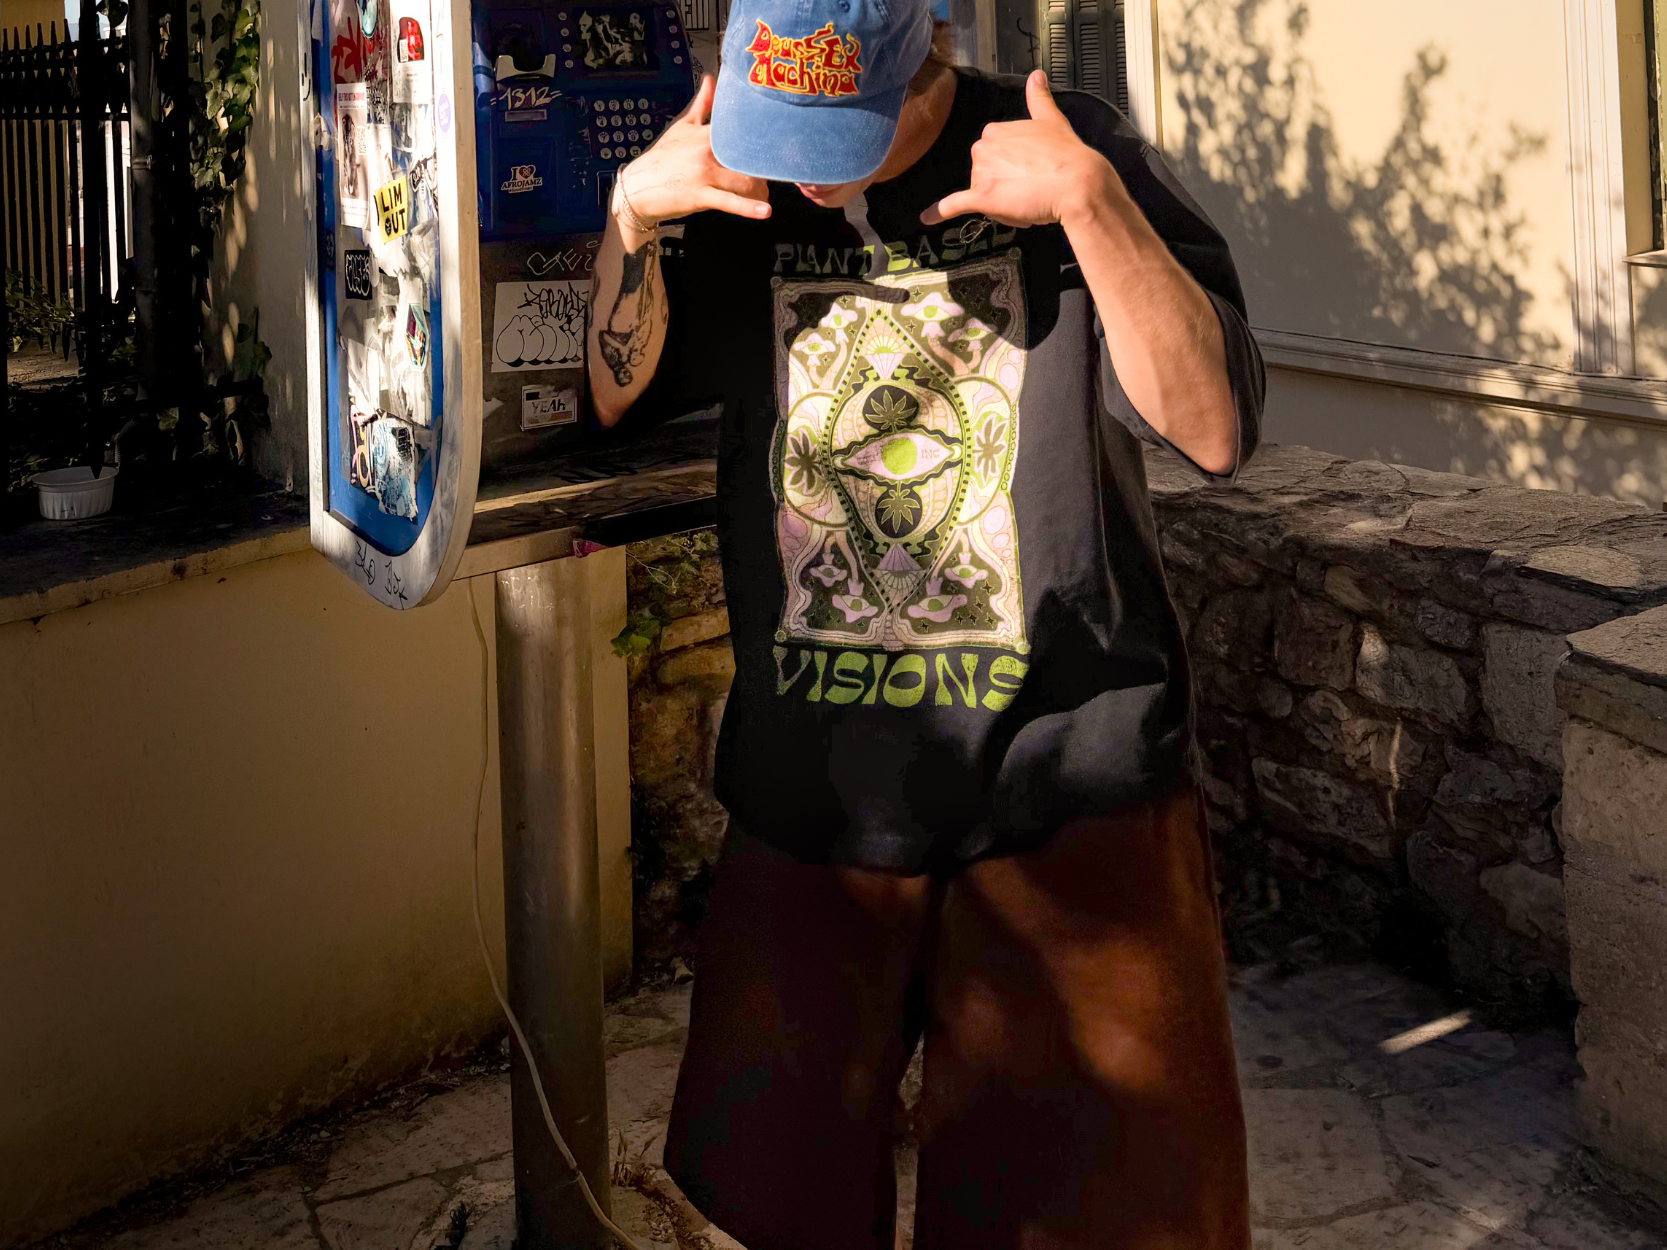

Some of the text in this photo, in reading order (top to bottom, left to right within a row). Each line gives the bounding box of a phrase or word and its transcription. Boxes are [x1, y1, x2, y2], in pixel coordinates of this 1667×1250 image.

[748, 52, 859, 97] Machina
[502, 178, 542, 190] AFROJAMZ
[512, 168, 519, 180] I
[772, 645, 1030, 713] VISIONS
